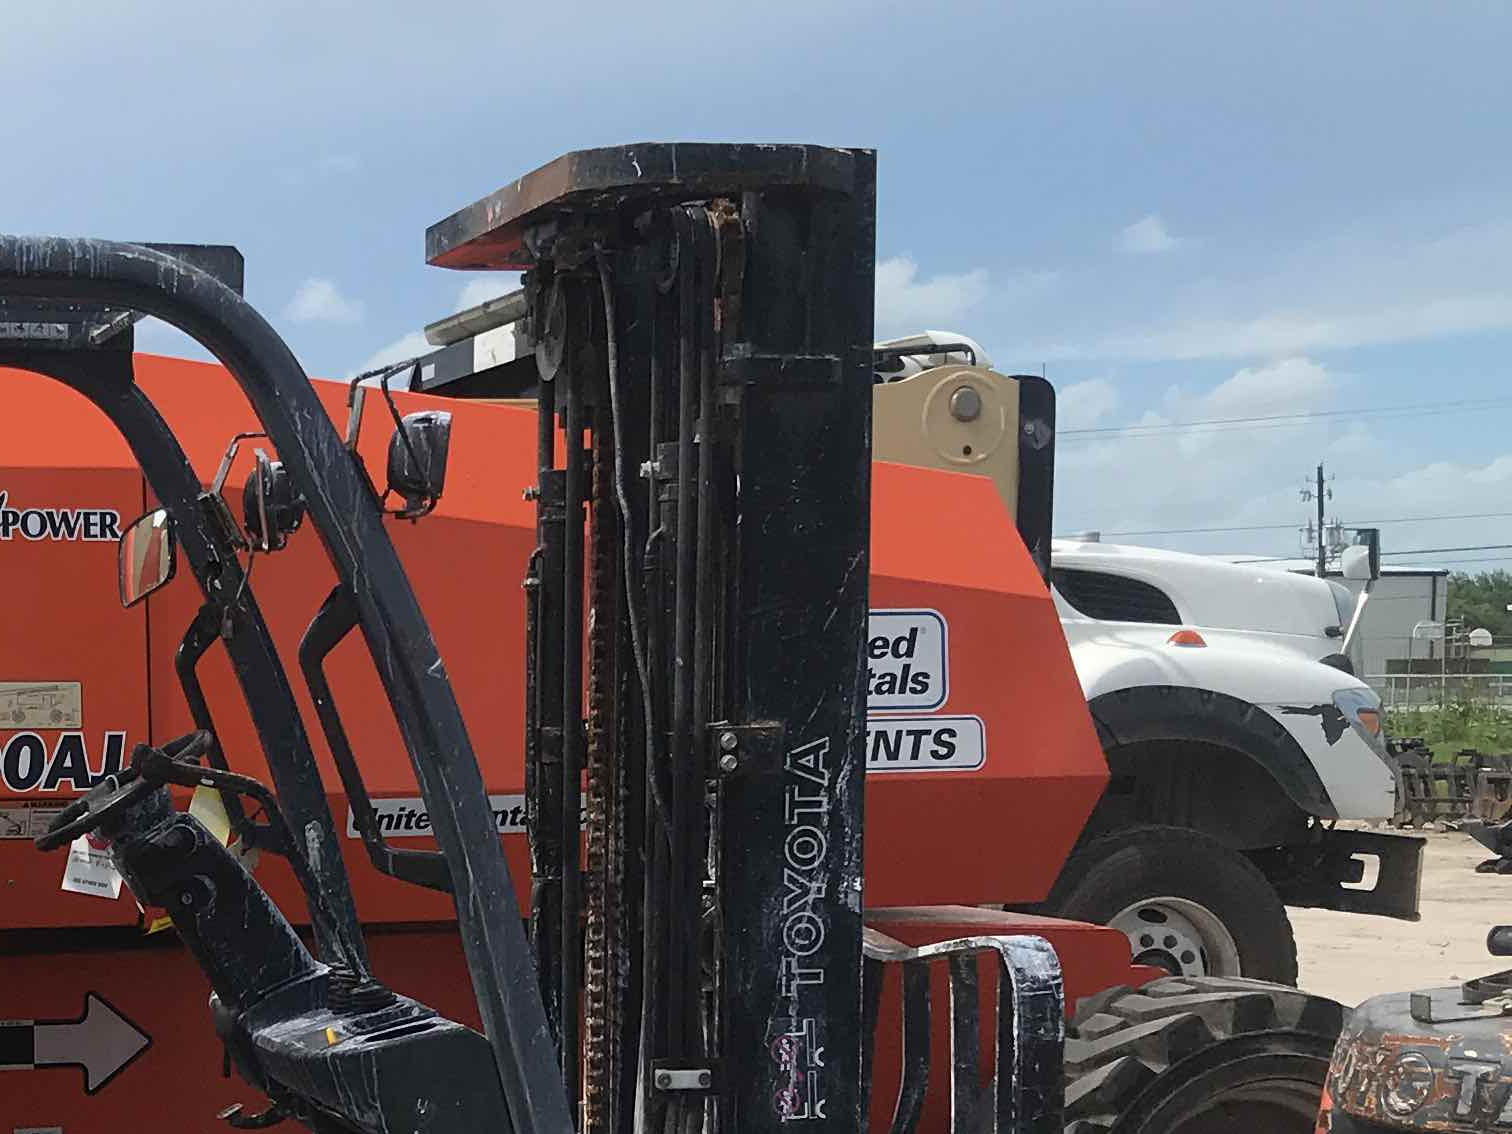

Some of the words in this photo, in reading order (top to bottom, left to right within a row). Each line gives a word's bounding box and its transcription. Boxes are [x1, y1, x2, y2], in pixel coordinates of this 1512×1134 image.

[0, 507, 121, 541] POWER
[867, 663, 930, 696] tals
[782, 736, 831, 997] TOYOTA
